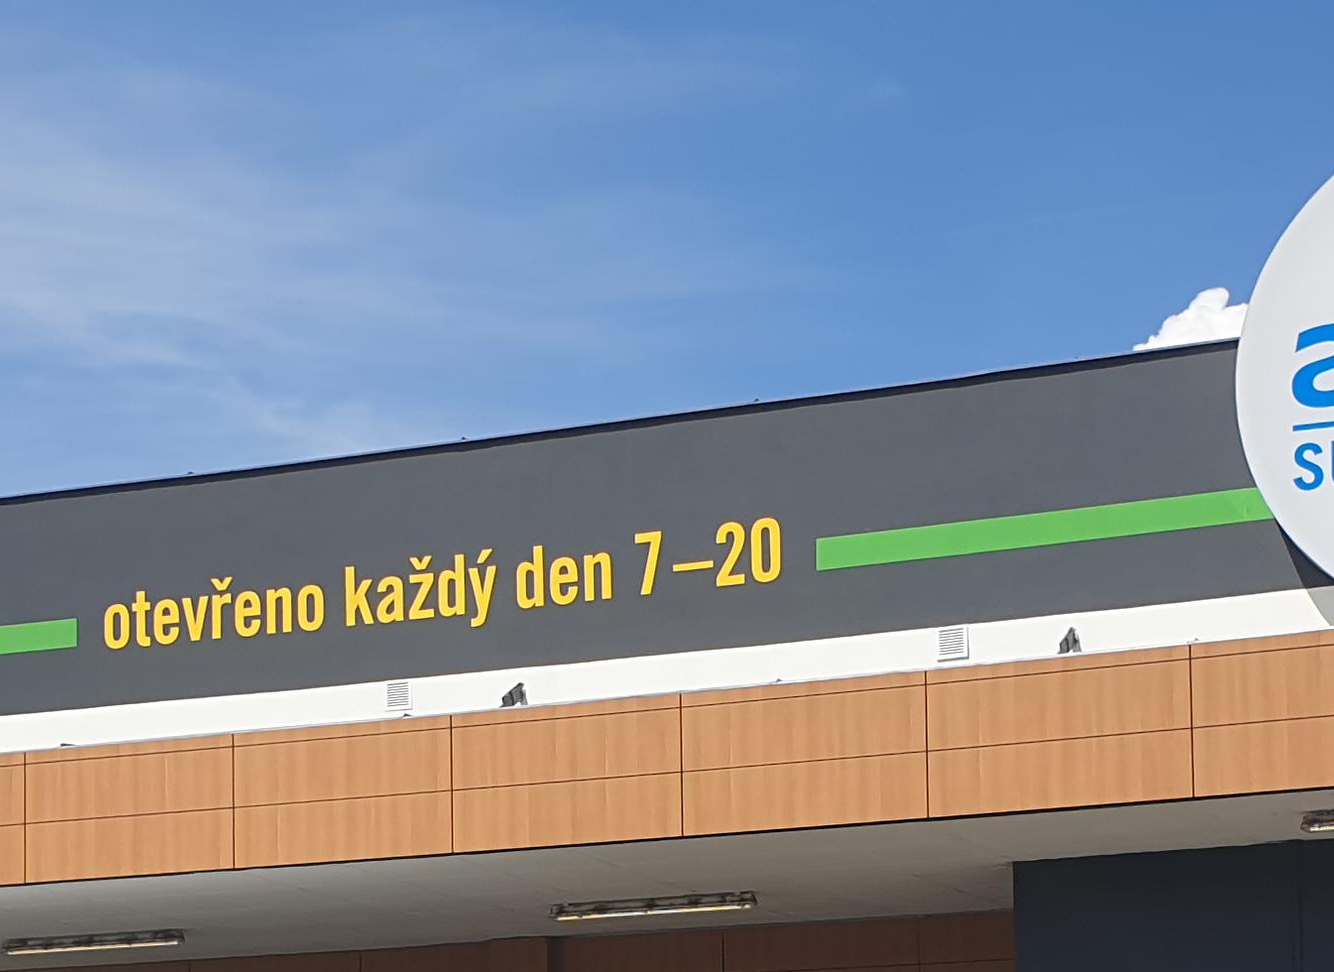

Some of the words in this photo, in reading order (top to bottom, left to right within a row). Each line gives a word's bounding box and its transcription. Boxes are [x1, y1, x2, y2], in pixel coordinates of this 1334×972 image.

[103, 577, 325, 650] otevřeno
[344, 549, 498, 628] každý
[515, 545, 613, 608] den
